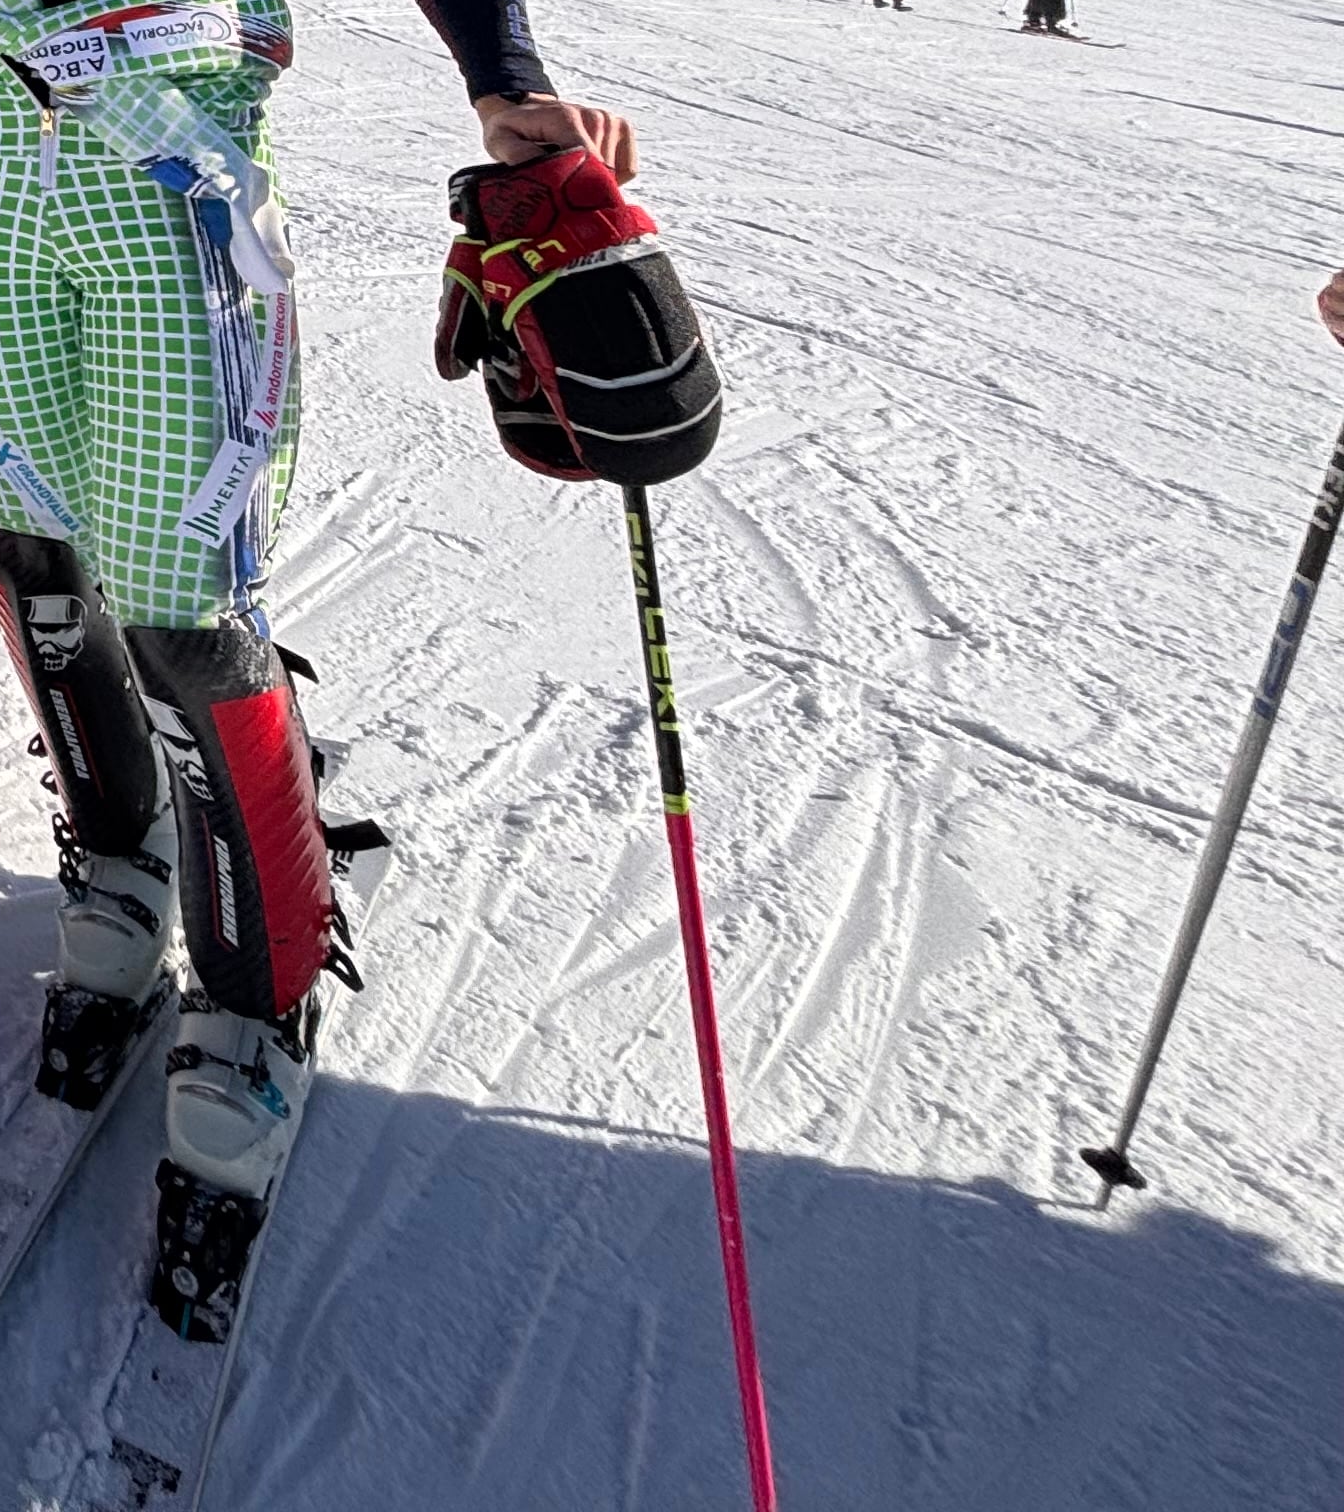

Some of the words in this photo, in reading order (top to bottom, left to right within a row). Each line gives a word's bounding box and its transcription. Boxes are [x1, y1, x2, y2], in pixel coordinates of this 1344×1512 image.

[131, 19, 204, 42] FACTORIA
[274, 292, 287, 349] telecom
[266, 353, 284, 406] andorra
[17, 463, 80, 533] GRANDVALIRA
[210, 454, 253, 516] MENTA
[644, 607, 681, 732] LEKI
[49, 688, 90, 780] ENERGIAPURA
